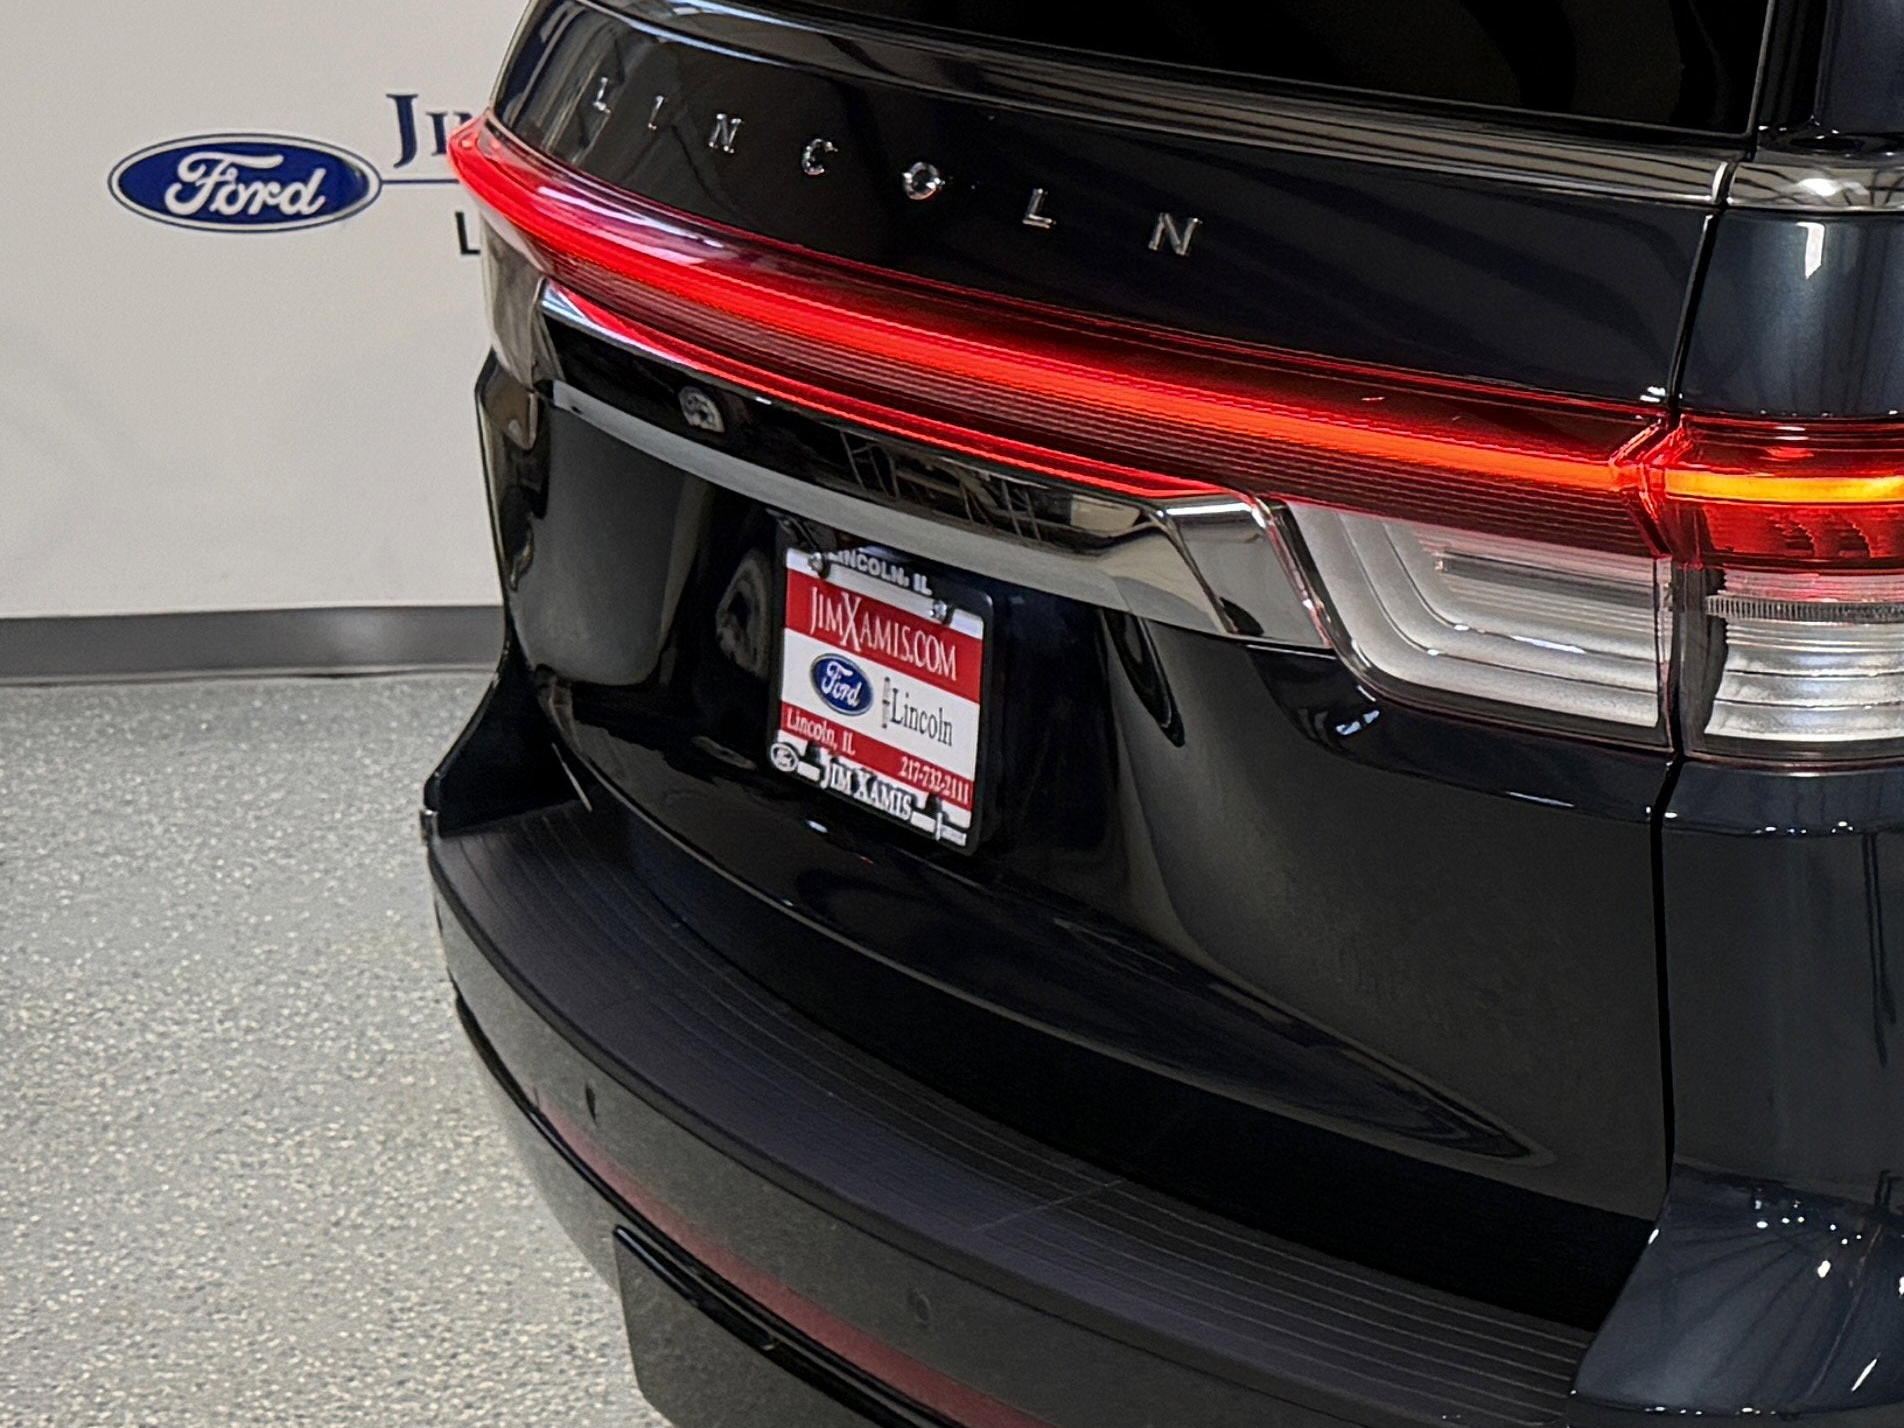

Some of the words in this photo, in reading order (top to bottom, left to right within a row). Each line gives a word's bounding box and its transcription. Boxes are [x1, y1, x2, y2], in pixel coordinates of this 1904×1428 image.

[163, 151, 327, 217] Ford
[591, 76, 1203, 257] LINCOLN
[820, 661, 862, 706] Ford
[890, 687, 953, 747] Lincoln
